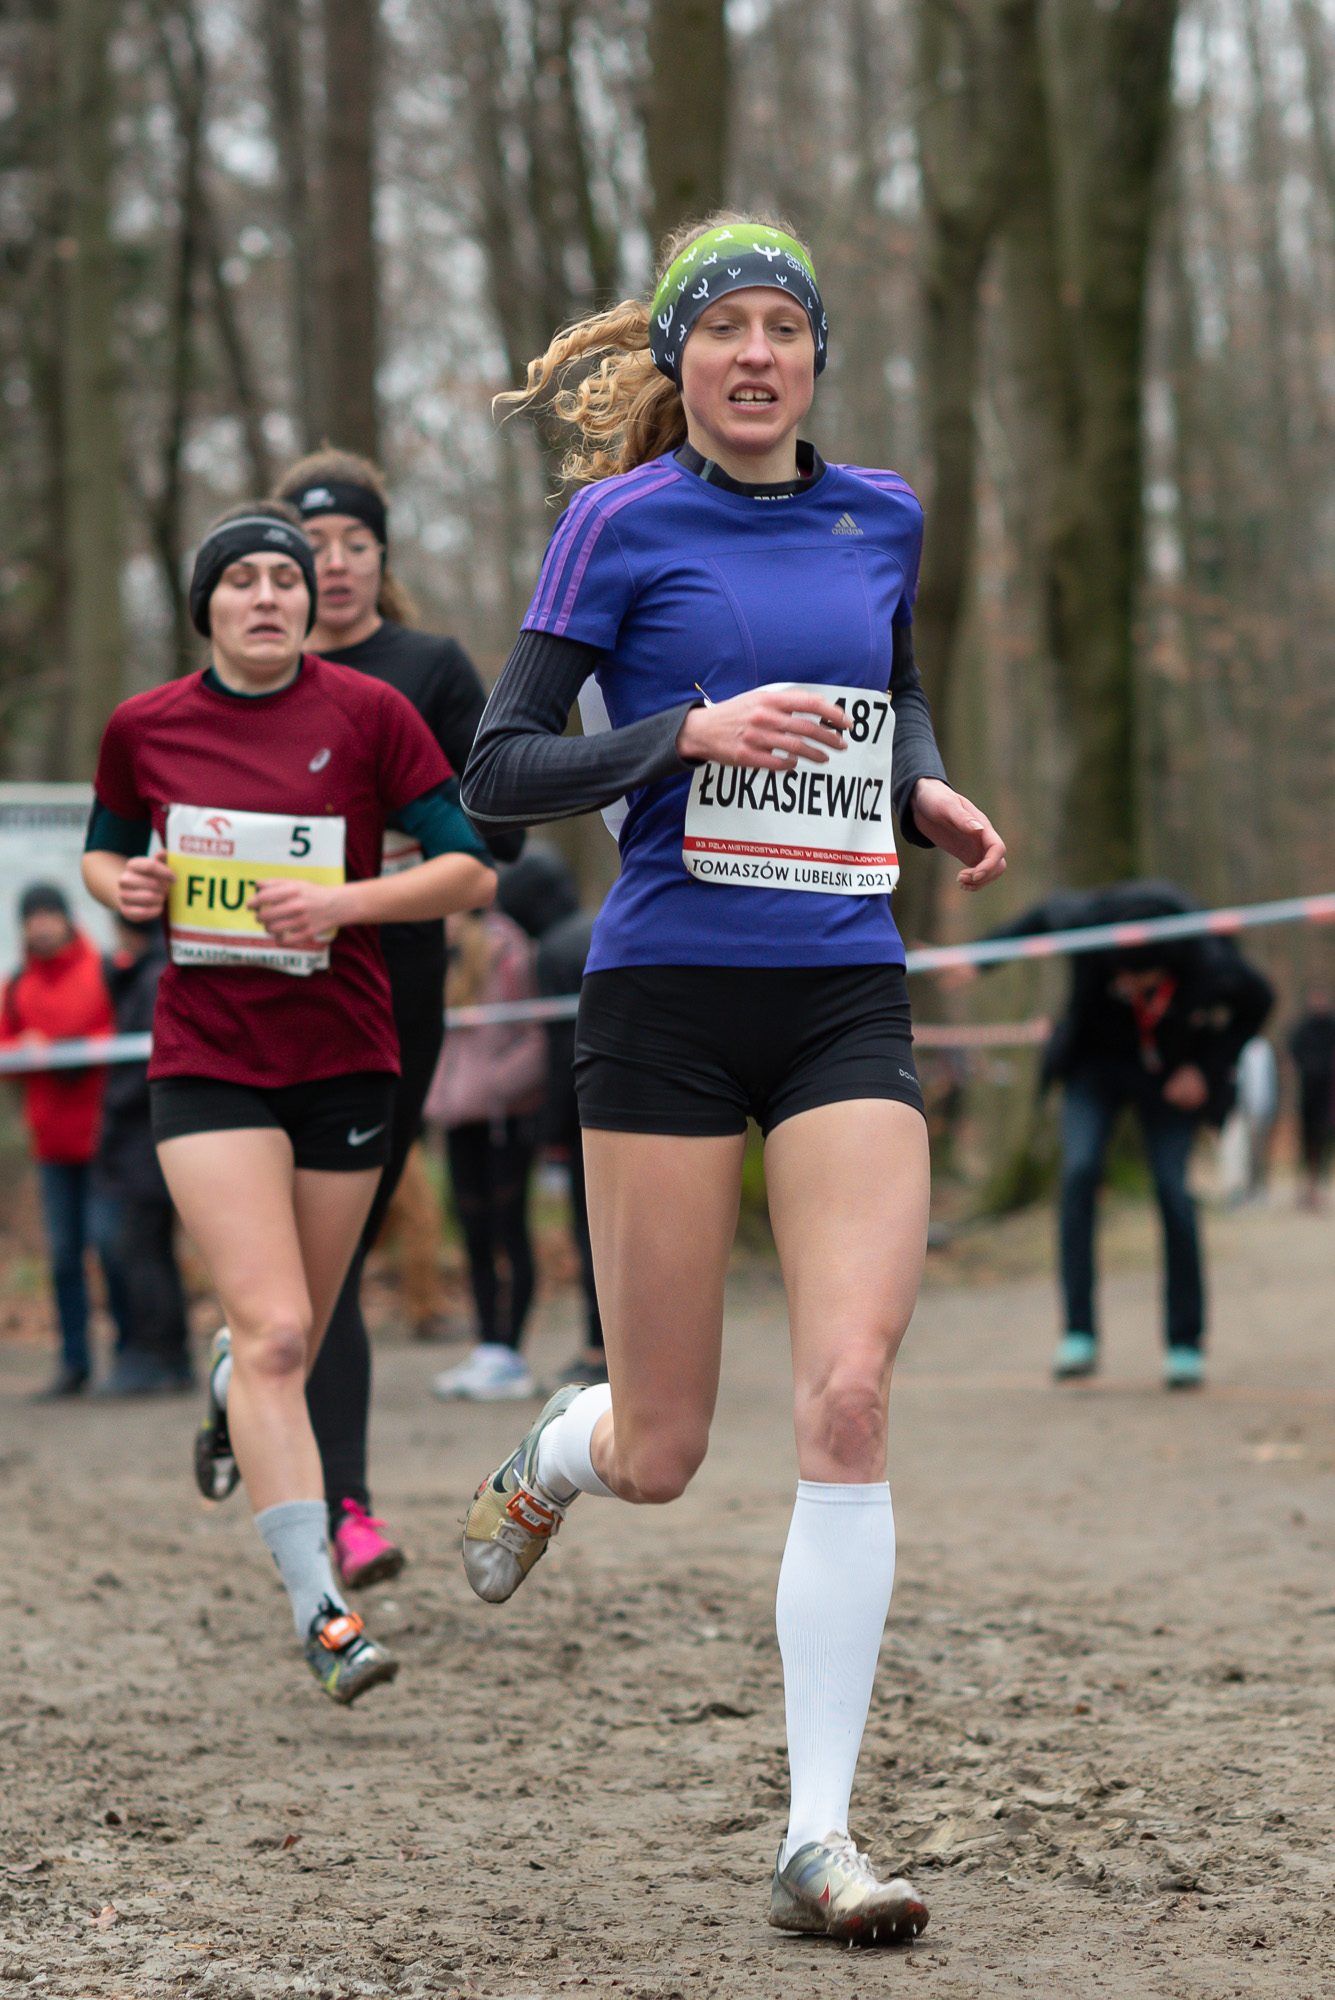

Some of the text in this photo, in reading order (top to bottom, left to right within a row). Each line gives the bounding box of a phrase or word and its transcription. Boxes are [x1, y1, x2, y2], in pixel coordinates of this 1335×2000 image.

[831, 527, 864, 536] adidas
[698, 762, 884, 822] ŁUKASIEWICZ
[288, 824, 312, 857] 5
[708, 842, 727, 851] PZLA
[779, 847, 804, 857] POLSKI
[805, 850, 812, 858] W
[812, 851, 842, 861] BIEGACH
[692, 858, 892, 887] TOMASZÓW LUBELSKI 2021
[173, 946, 242, 963] OMASZÓW
